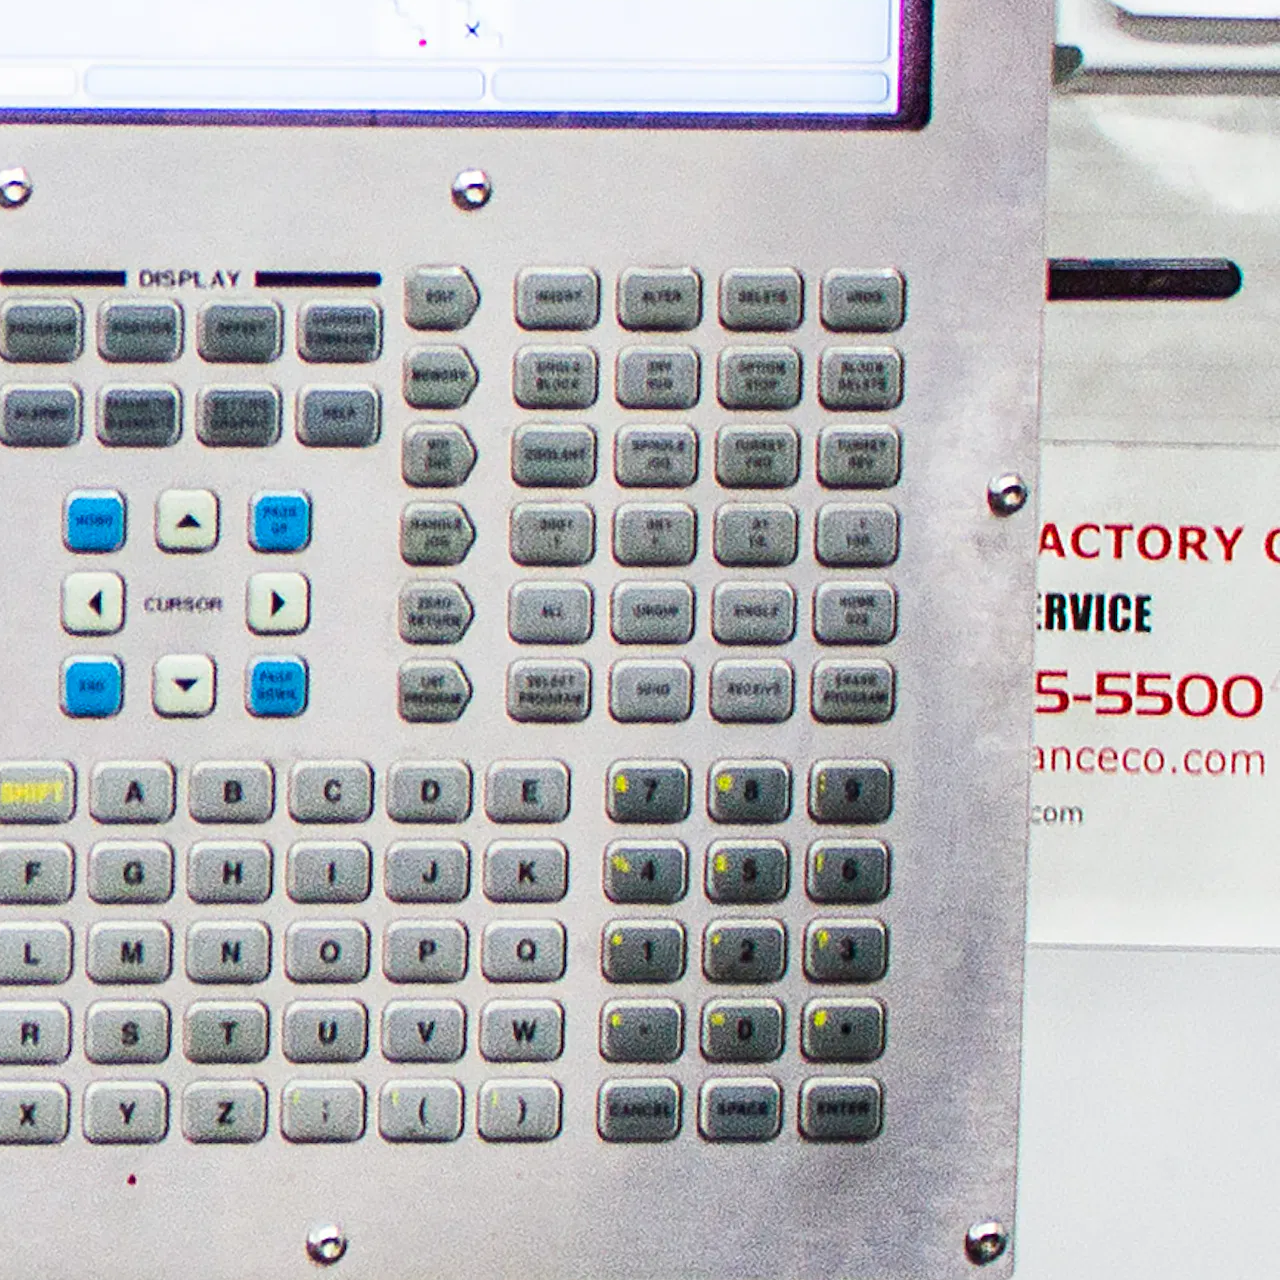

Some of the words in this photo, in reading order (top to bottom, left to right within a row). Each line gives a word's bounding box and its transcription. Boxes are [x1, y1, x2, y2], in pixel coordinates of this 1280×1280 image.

[138, 269, 241, 289] DISPLAY
[143, 595, 224, 612] CURSOR
[0, 781, 65, 805] SHIFT
[125, 781, 144, 803] A
[223, 780, 243, 804] B
[323, 779, 342, 804] C
[421, 780, 441, 804] D
[521, 780, 537, 804] E
[645, 779, 658, 804] 7
[744, 780, 760, 803] 8
[845, 779, 860, 803] 9
[25, 861, 40, 884] F
[123, 861, 145, 886] G
[223, 862, 243, 884] H
[328, 862, 336, 885] I
[422, 862, 439, 884] J
[518, 863, 536, 883] K
[641, 861, 656, 883] 4
[743, 860, 759, 883] 5
[842, 860, 859, 883] 6
[23, 943, 40, 966] L
[121, 942, 143, 964] M
[221, 942, 241, 964] N
[319, 940, 341, 964] O
[418, 940, 436, 962] P
[516, 939, 537, 962] Q
[644, 941, 654, 963] 1
[740, 940, 755, 963] 2
[841, 940, 857, 962] 3
[21, 1022, 40, 1045] R
[121, 1022, 140, 1046] S
[222, 1022, 237, 1045] T
[318, 1022, 338, 1045] U
[418, 1022, 435, 1044] V
[513, 1021, 536, 1042] W
[20, 1104, 36, 1126] X
[119, 1103, 136, 1125] Y
[217, 1101, 234, 1126] Z
